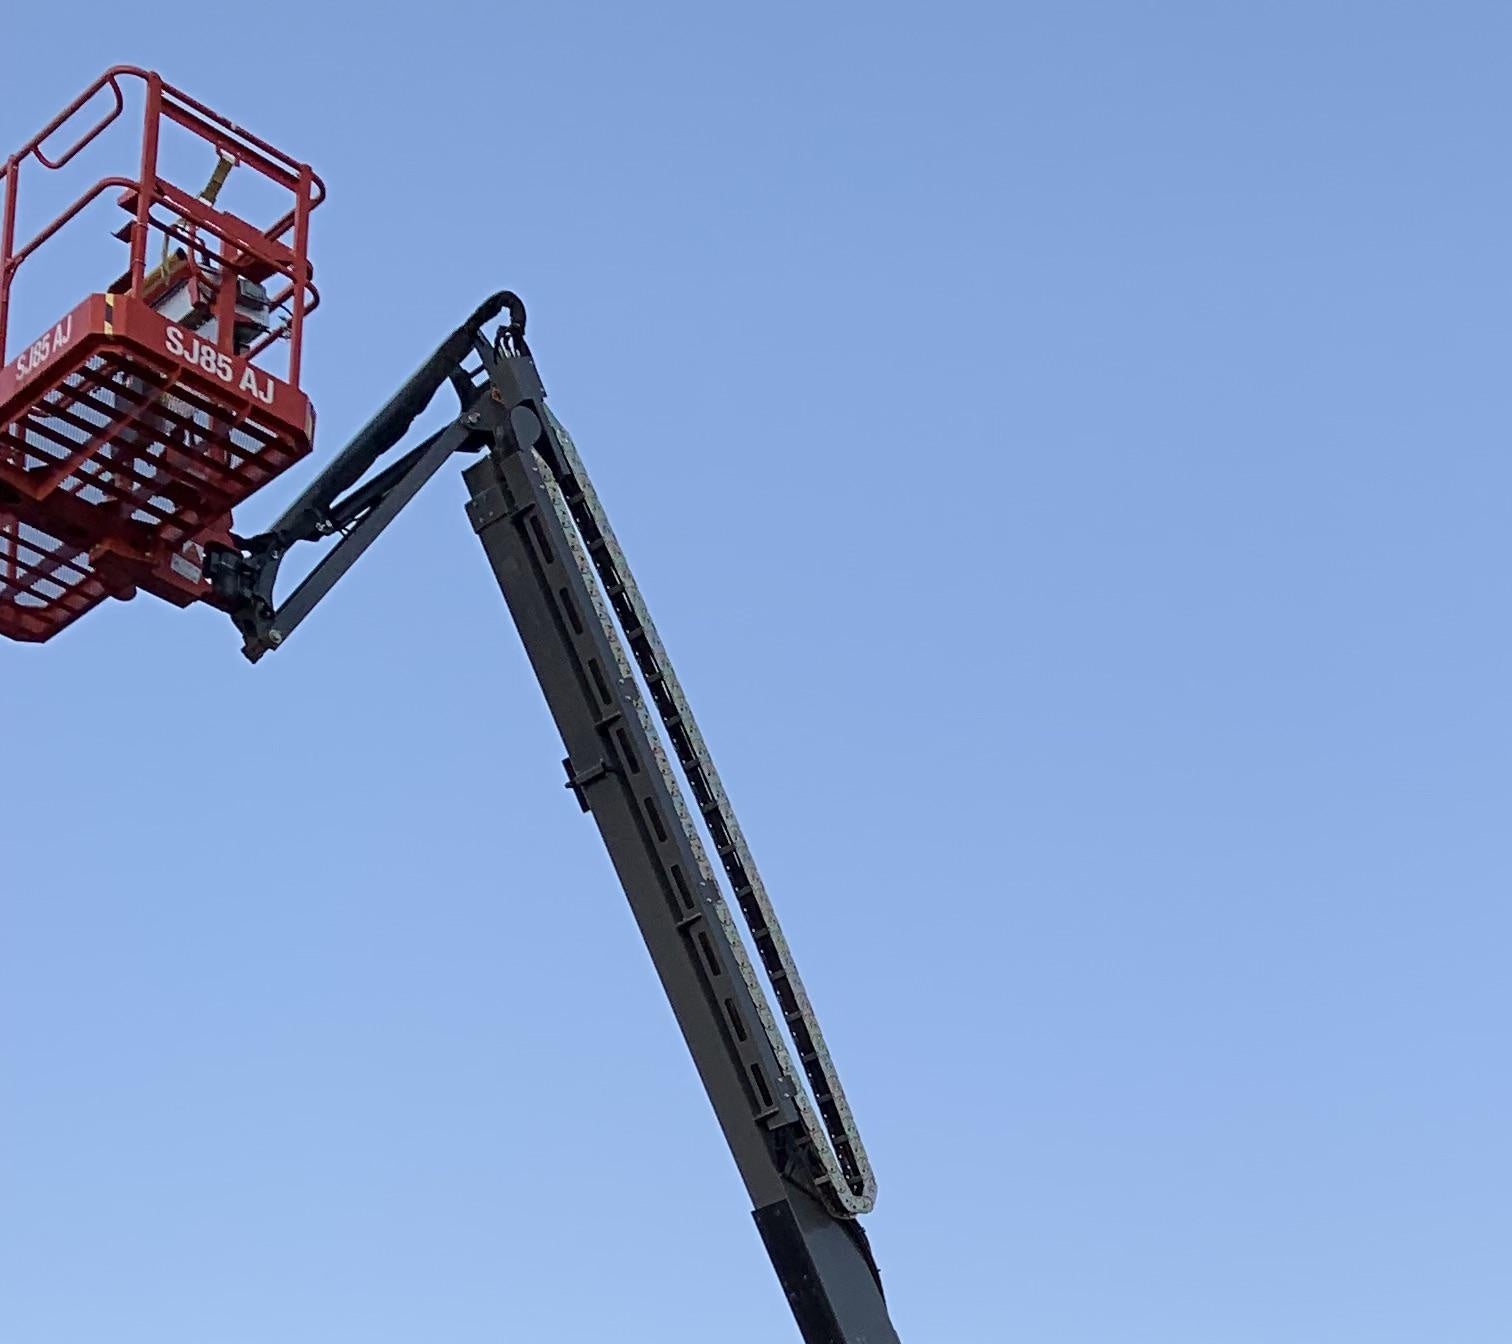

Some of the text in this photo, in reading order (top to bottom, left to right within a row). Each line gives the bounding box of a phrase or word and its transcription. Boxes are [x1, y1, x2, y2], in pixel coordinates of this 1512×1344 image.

[16, 315, 73, 382] SJ85 AJ
[165, 326, 275, 404] SJ85 AJ
